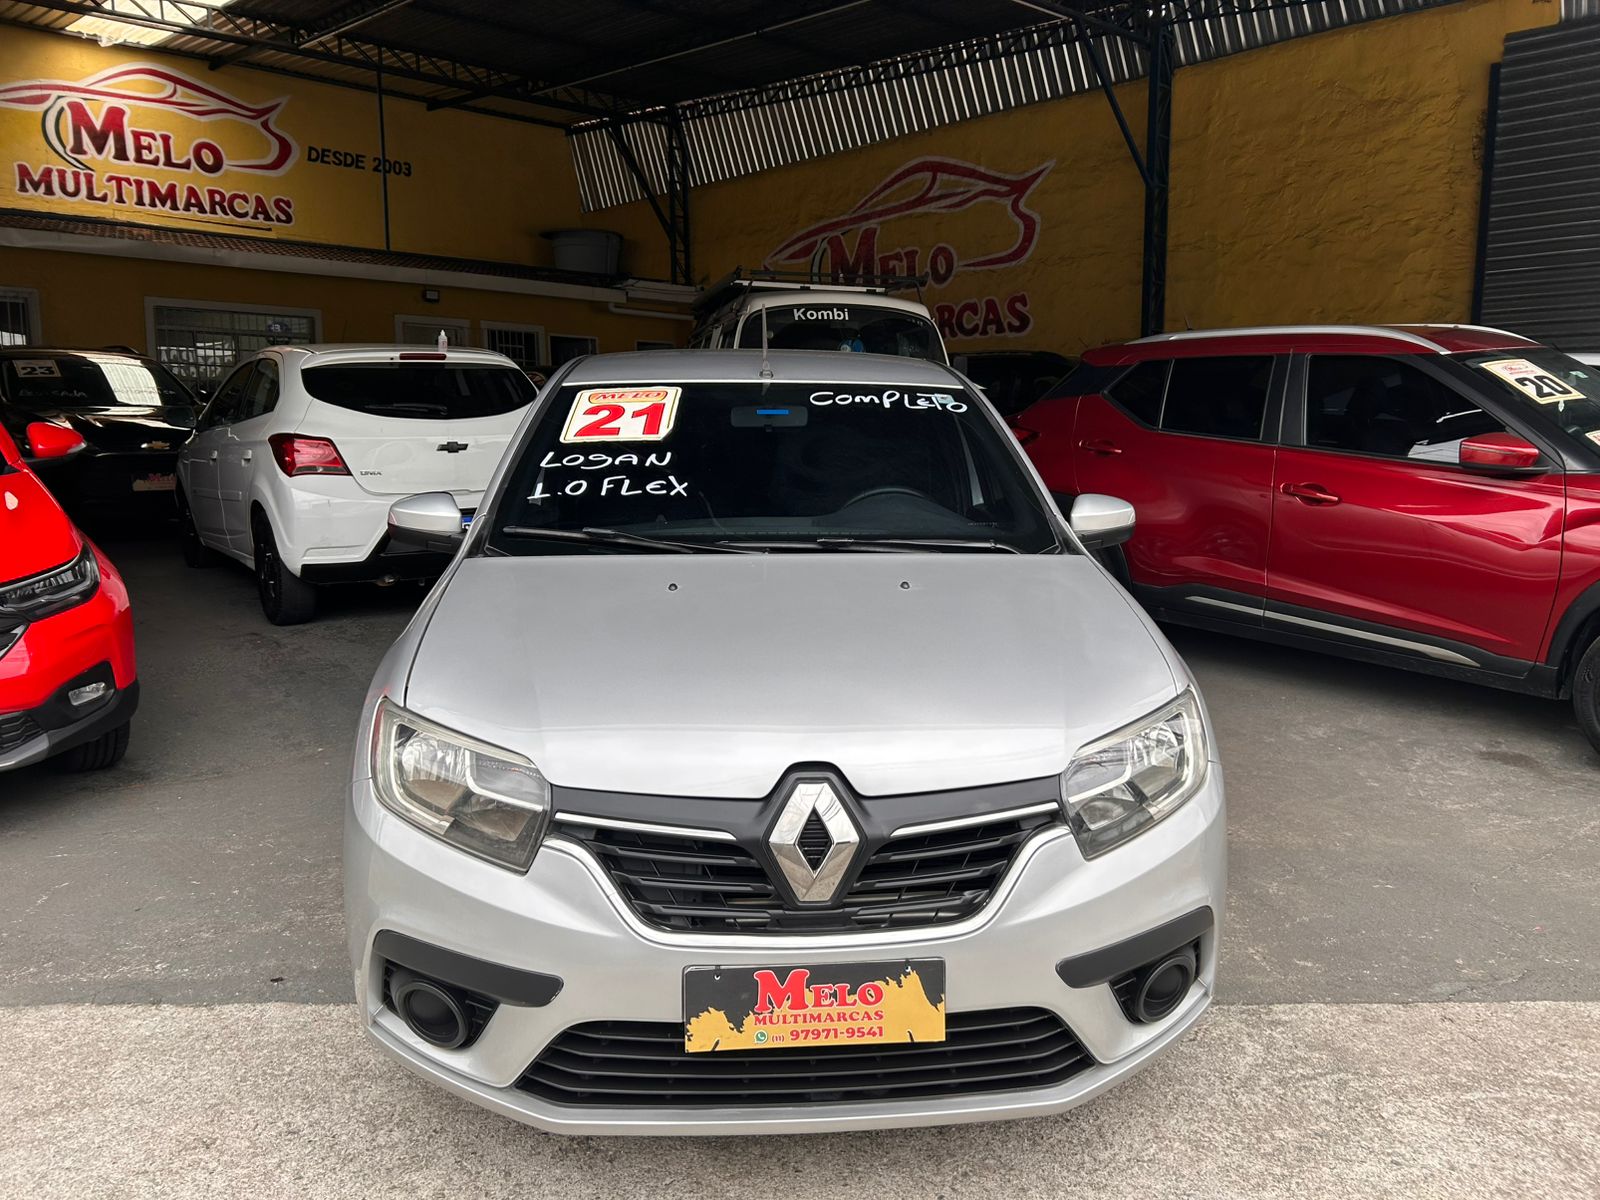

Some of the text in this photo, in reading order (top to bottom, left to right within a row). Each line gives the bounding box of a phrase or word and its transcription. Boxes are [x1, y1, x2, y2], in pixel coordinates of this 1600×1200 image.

[67, 101, 225, 175] MELO
[307, 146, 413, 178] DESDE 2003
[16, 163, 294, 226] MULTIMARCAS
[792, 308, 850, 322] Kombi
[20, 366, 56, 376] 23
[1514, 375, 1573, 399] 20
[574, 402, 666, 437] 21
[526, 475, 689, 500] 1.0 FLEX
[754, 969, 884, 1014] MELO
[753, 1010, 884, 1026] MULTIMARCAS
[790, 1026, 884, 1042] 97971-9541
